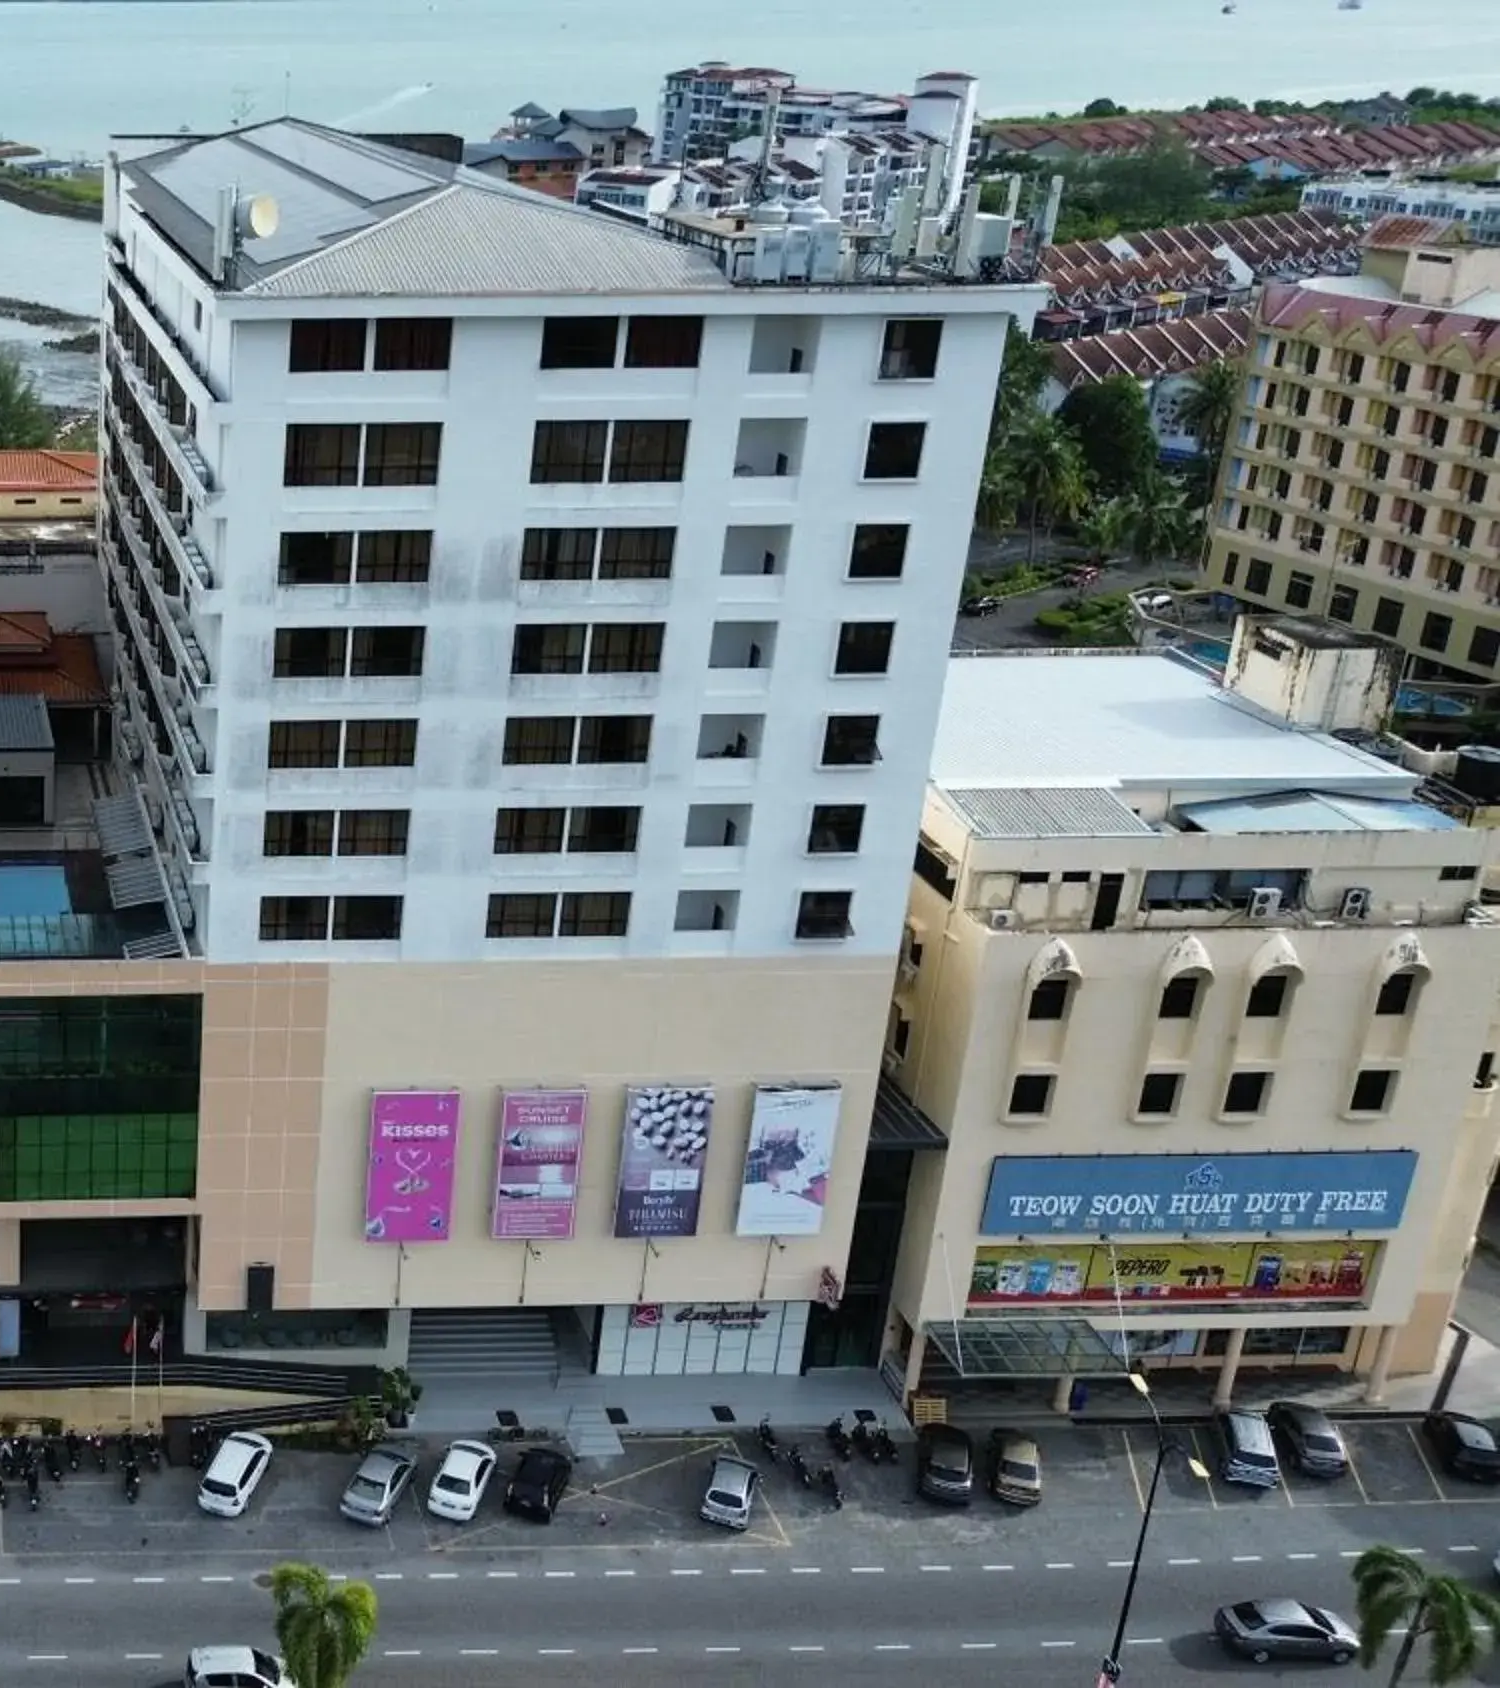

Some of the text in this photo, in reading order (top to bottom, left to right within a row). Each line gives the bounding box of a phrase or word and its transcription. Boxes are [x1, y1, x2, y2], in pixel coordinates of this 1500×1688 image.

[1008, 1190, 1389, 1217] TEOW SOON HUAT DUTY FREE
[1109, 1258, 1172, 1277] PEPERO
